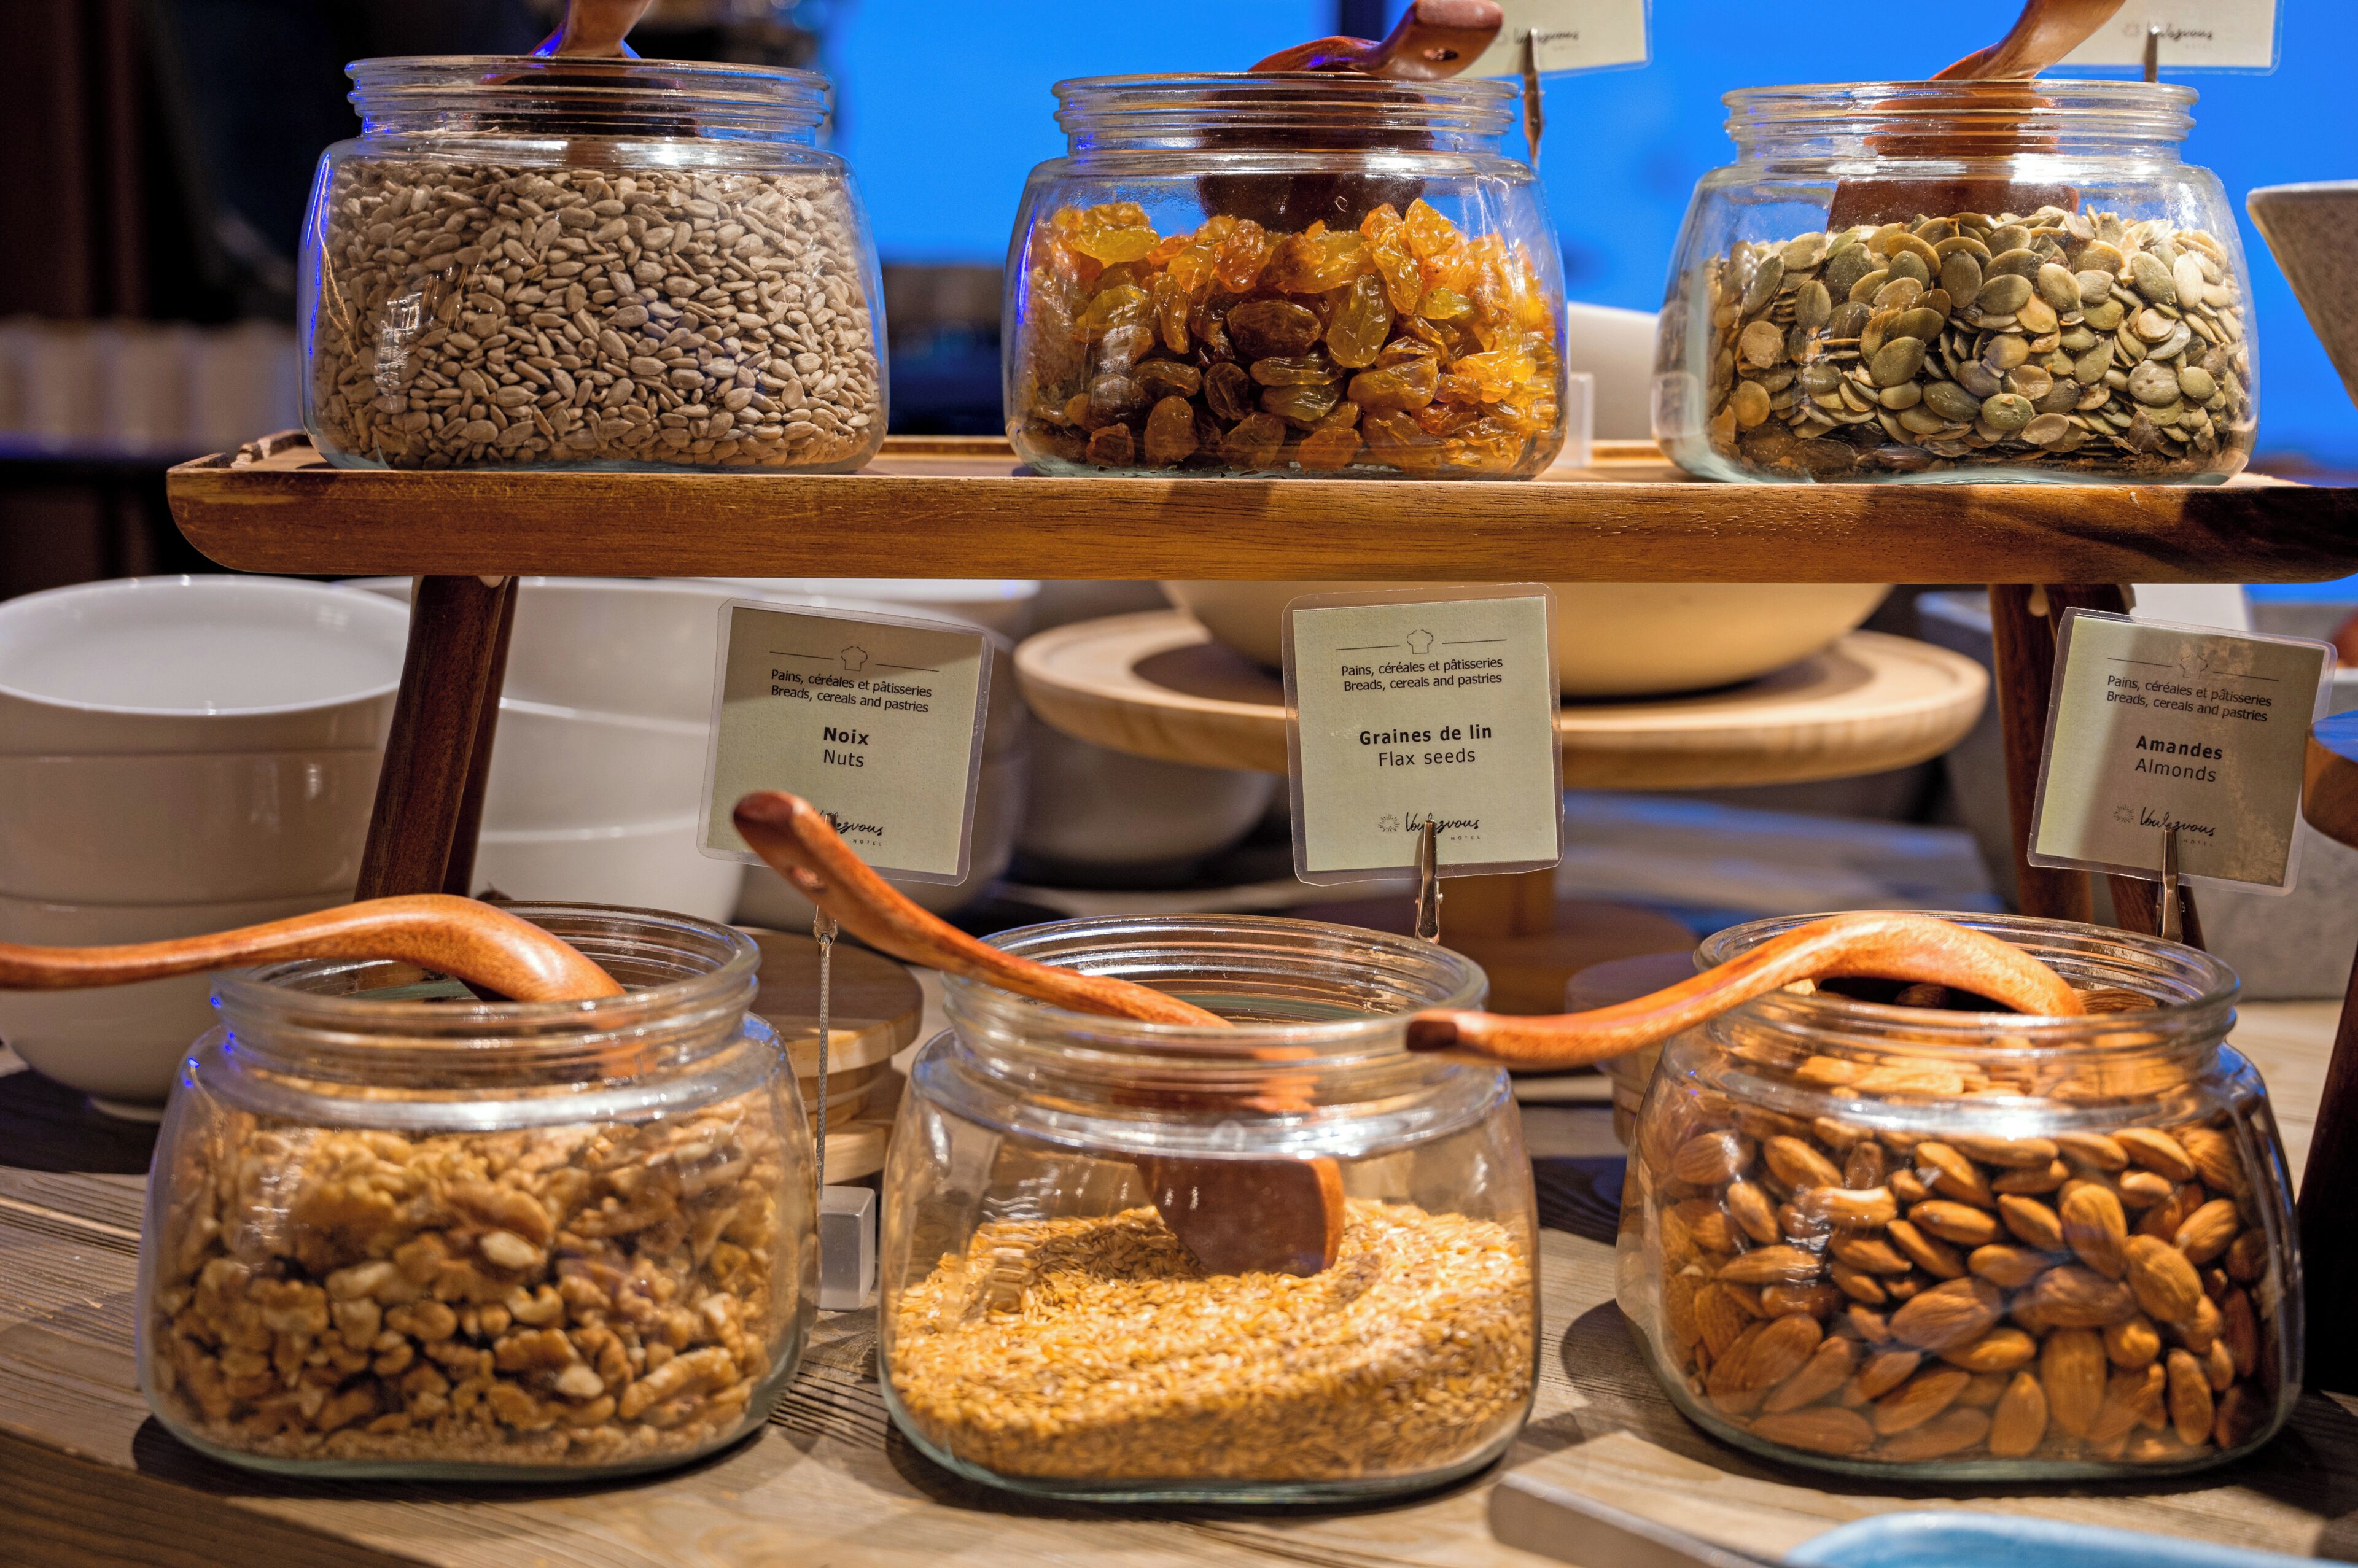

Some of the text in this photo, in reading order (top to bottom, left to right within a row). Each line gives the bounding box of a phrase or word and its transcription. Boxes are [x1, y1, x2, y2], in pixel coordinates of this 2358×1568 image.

[1342, 657, 1503, 677] Pains, céréales et pâtisseries
[771, 669, 932, 697] Pains, céréales et pâtisseries
[1344, 673, 1502, 692] Breads, cereals and pastries
[2107, 675, 2272, 707] Pains, céréales et pâtisseries
[771, 685, 928, 713] Breads, cereals and pastries
[2107, 691, 2268, 722] Breads, cereals and pastries
[823, 726, 869, 745] Noix
[1360, 724, 1492, 745] Graines de lin
[823, 749, 864, 767] Nuts
[1379, 748, 1476, 767] Flax seeds
[2136, 736, 2222, 759] Amandes
[2135, 758, 2217, 782] Almonds
